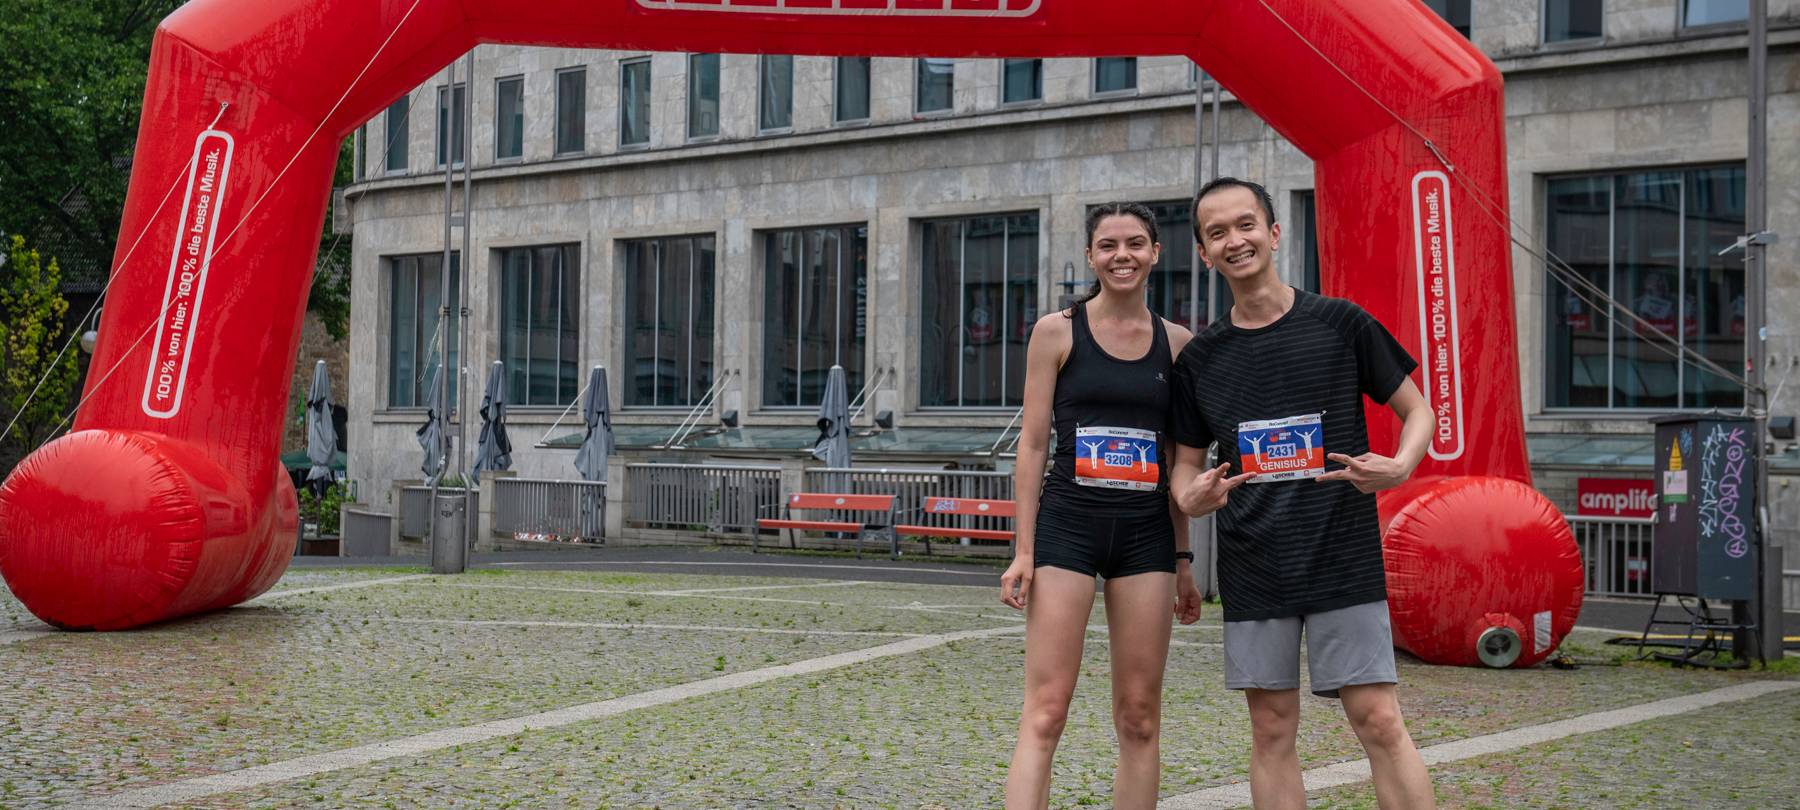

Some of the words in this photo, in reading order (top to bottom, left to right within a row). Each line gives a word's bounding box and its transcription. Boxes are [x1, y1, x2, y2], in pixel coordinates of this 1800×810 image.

[199, 148, 220, 192] Musik.
[191, 195, 210, 233] beste
[1426, 188, 1440, 233] Musik.
[187, 235, 201, 256] die
[1430, 235, 1442, 274] beste
[179, 259, 197, 299] 100%
[1431, 276, 1444, 297] die
[171, 302, 188, 330] hier.
[1432, 299, 1445, 341] 100%
[168, 333, 181, 356] von
[1435, 342, 1448, 372] hier.
[157, 360, 175, 400] 100%
[1440, 374, 1449, 398] von
[1438, 402, 1452, 443] 100%
[1105, 454, 1132, 466] 3208
[1260, 458, 1307, 471] GENISIUS
[1268, 445, 1295, 457] 2431
